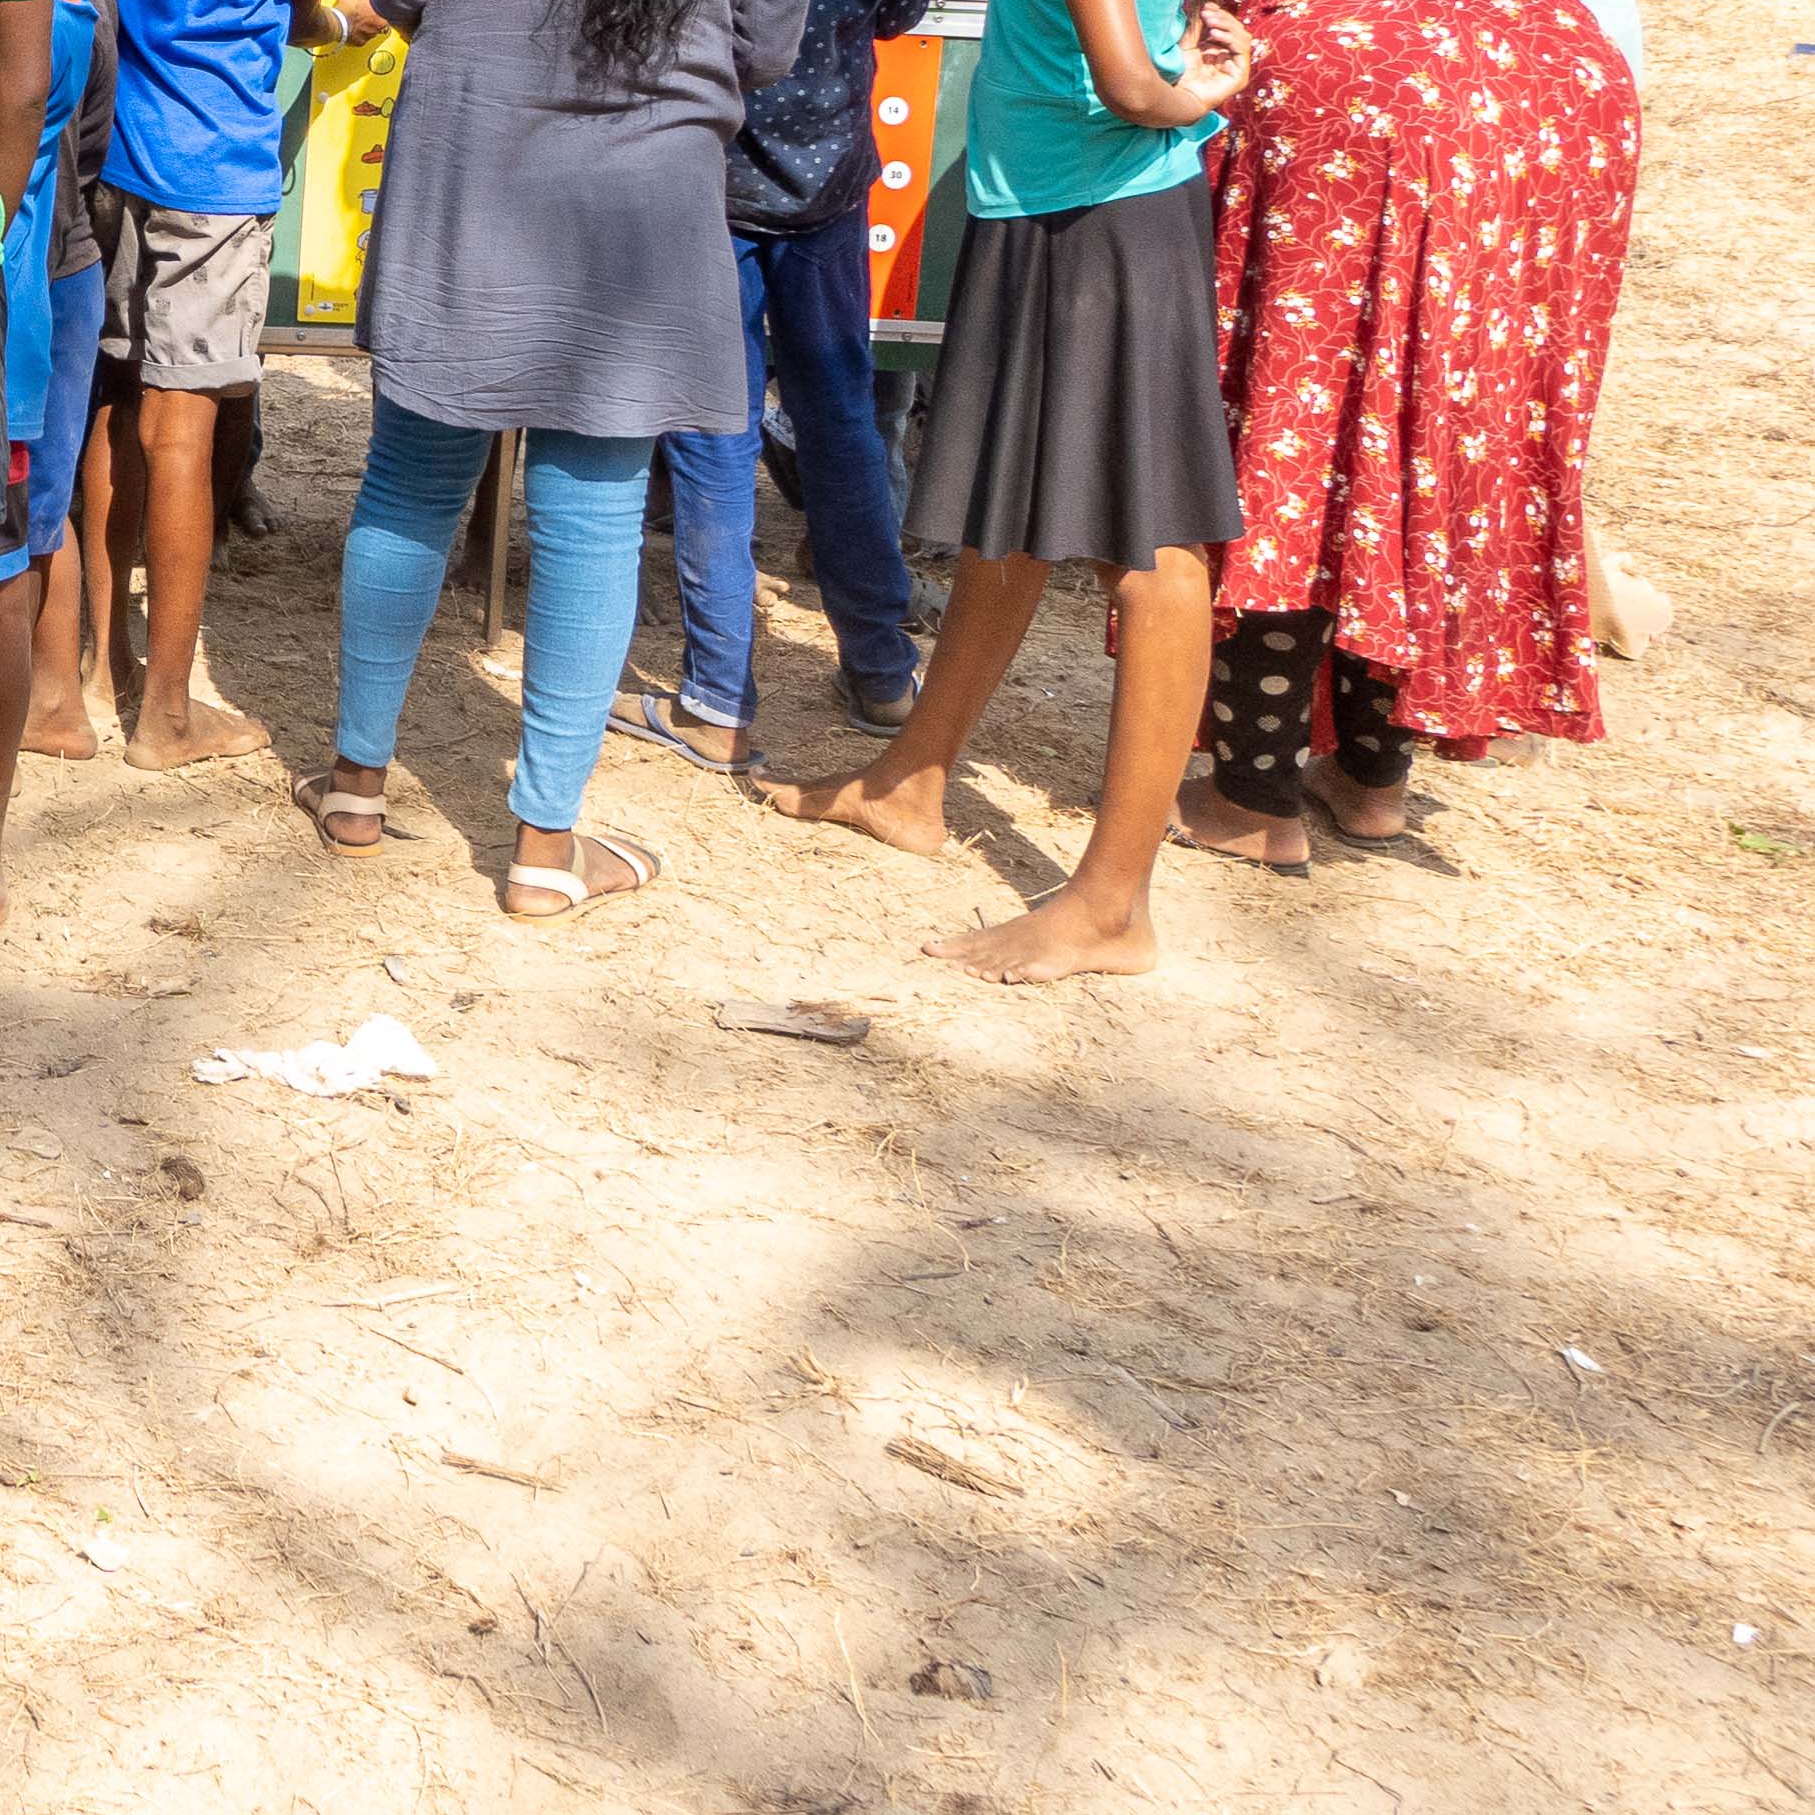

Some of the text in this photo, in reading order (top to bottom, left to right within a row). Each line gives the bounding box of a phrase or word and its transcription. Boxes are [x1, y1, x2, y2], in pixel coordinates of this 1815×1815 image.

[888, 106, 899, 115] 14
[890, 171, 903, 179] 30
[876, 234, 887, 243] 18
